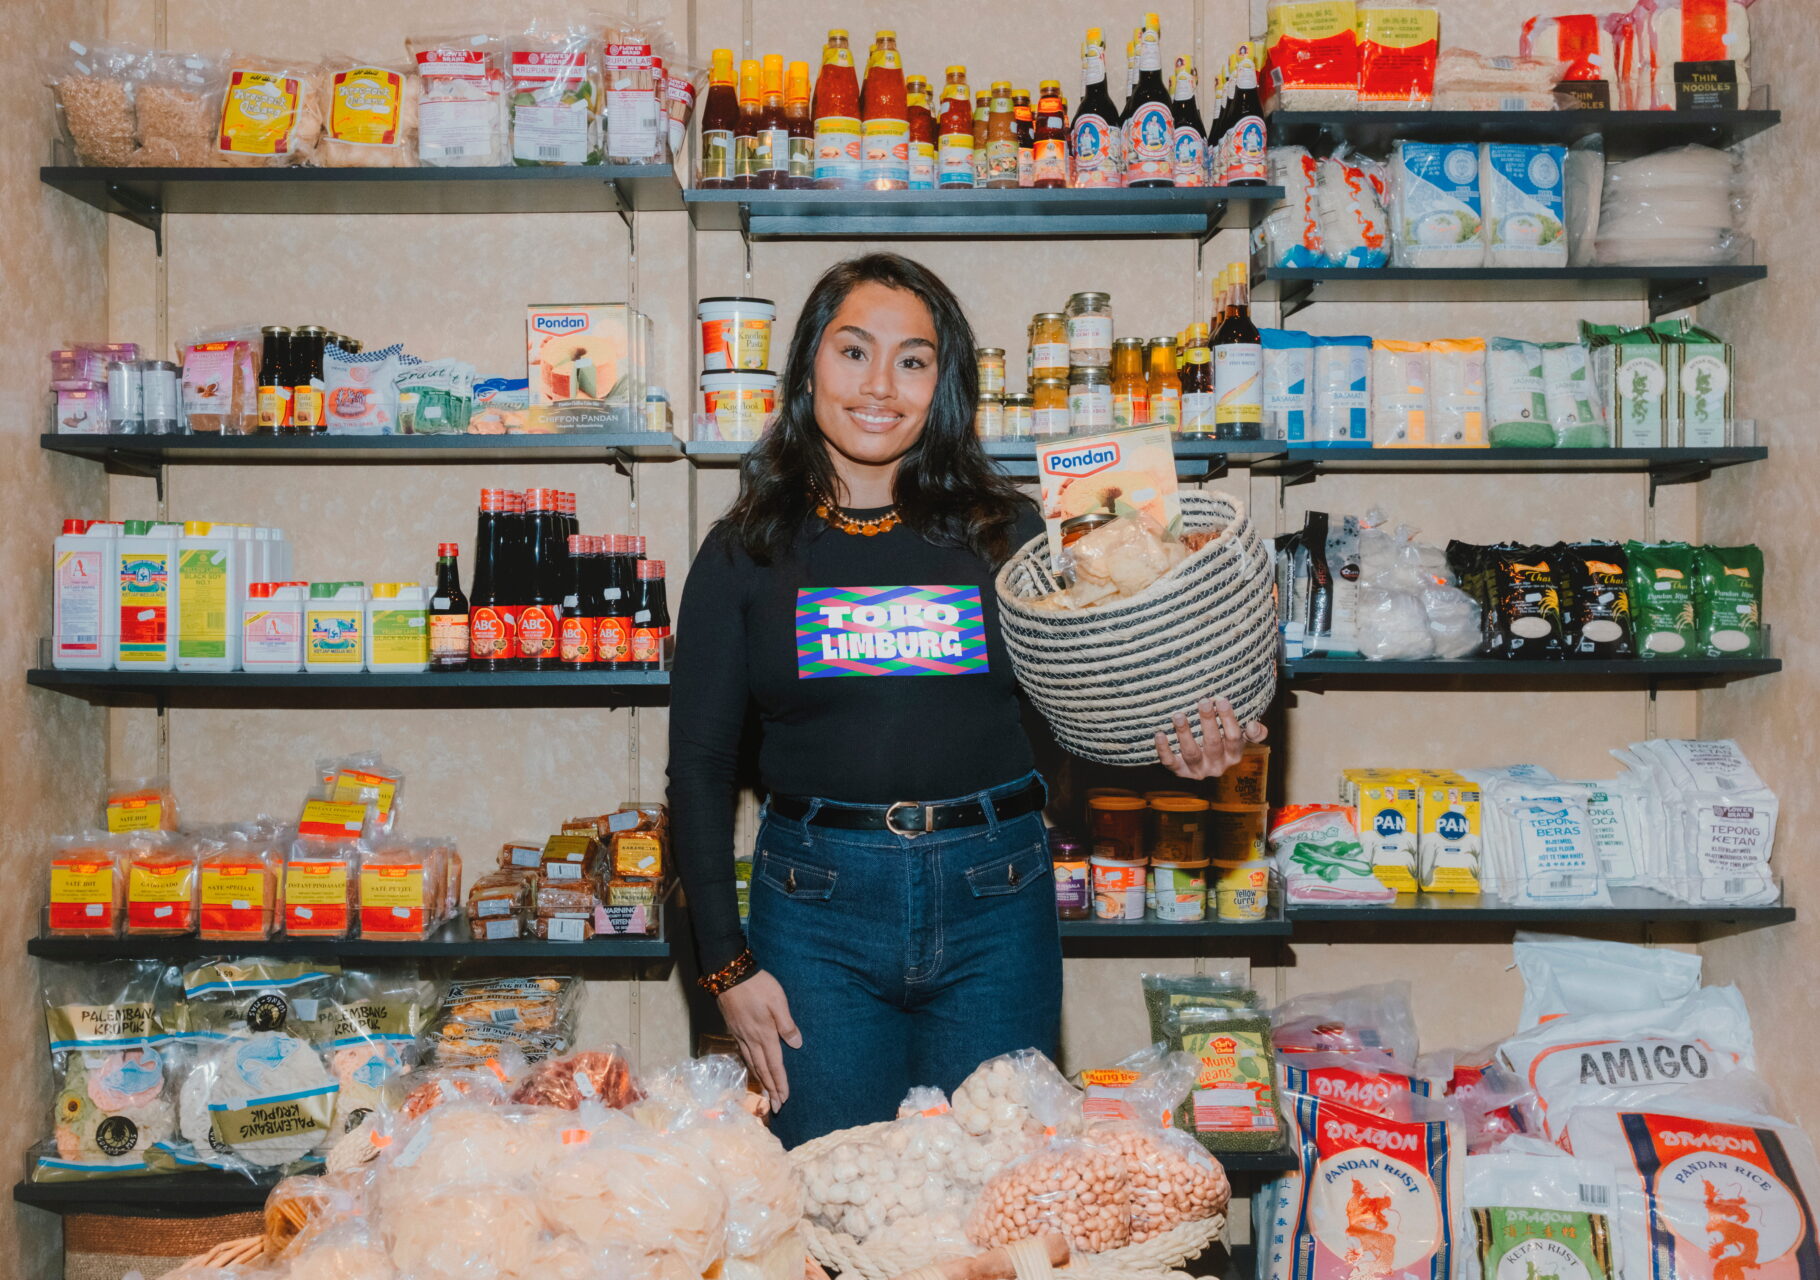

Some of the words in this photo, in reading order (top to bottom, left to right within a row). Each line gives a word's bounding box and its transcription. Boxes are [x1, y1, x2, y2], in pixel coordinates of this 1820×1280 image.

[1691, 74, 1718, 82] THIN
[1683, 84, 1730, 92] NOODLES
[537, 316, 585, 329] Pondan
[581, 414, 619, 422] PANDAN
[1050, 448, 1115, 470] Pondan
[819, 603, 960, 628] TOKO
[473, 619, 497, 631] ABC
[521, 618, 546, 630] ABC
[562, 628, 581, 638] ABC
[599, 628, 620, 638] ABC
[821, 630, 963, 660] LIMBURG
[1536, 826, 1581, 837] BERAS
[1710, 825, 1761, 836] TEPONG
[1711, 836, 1756, 846] KETAN
[1235, 889, 1257, 898] Yellow
[1233, 896, 1255, 905] curry
[94, 1020, 145, 1036] KRUPUK
[1202, 1056, 1236, 1068] Mung
[1579, 1044, 1709, 1086] AMIGO
[1085, 1073, 1120, 1084] Mung
[1315, 1076, 1404, 1106] DRAGON
[250, 1102, 300, 1122] KRUPUK
[239, 1115, 317, 1139] PALEMBANG
[1323, 1119, 1419, 1151] DRAGON
[1658, 1130, 1758, 1153] DRAGON
[1324, 1158, 1380, 1185] PANDAN
[1383, 1163, 1420, 1195] RIJST
[1674, 1159, 1728, 1185] PANDAN
[1734, 1165, 1773, 1192] RICE
[1505, 1209, 1573, 1225] DRAGON
[1506, 1241, 1544, 1265] KETAN
[1546, 1242, 1579, 1267] RIJST
